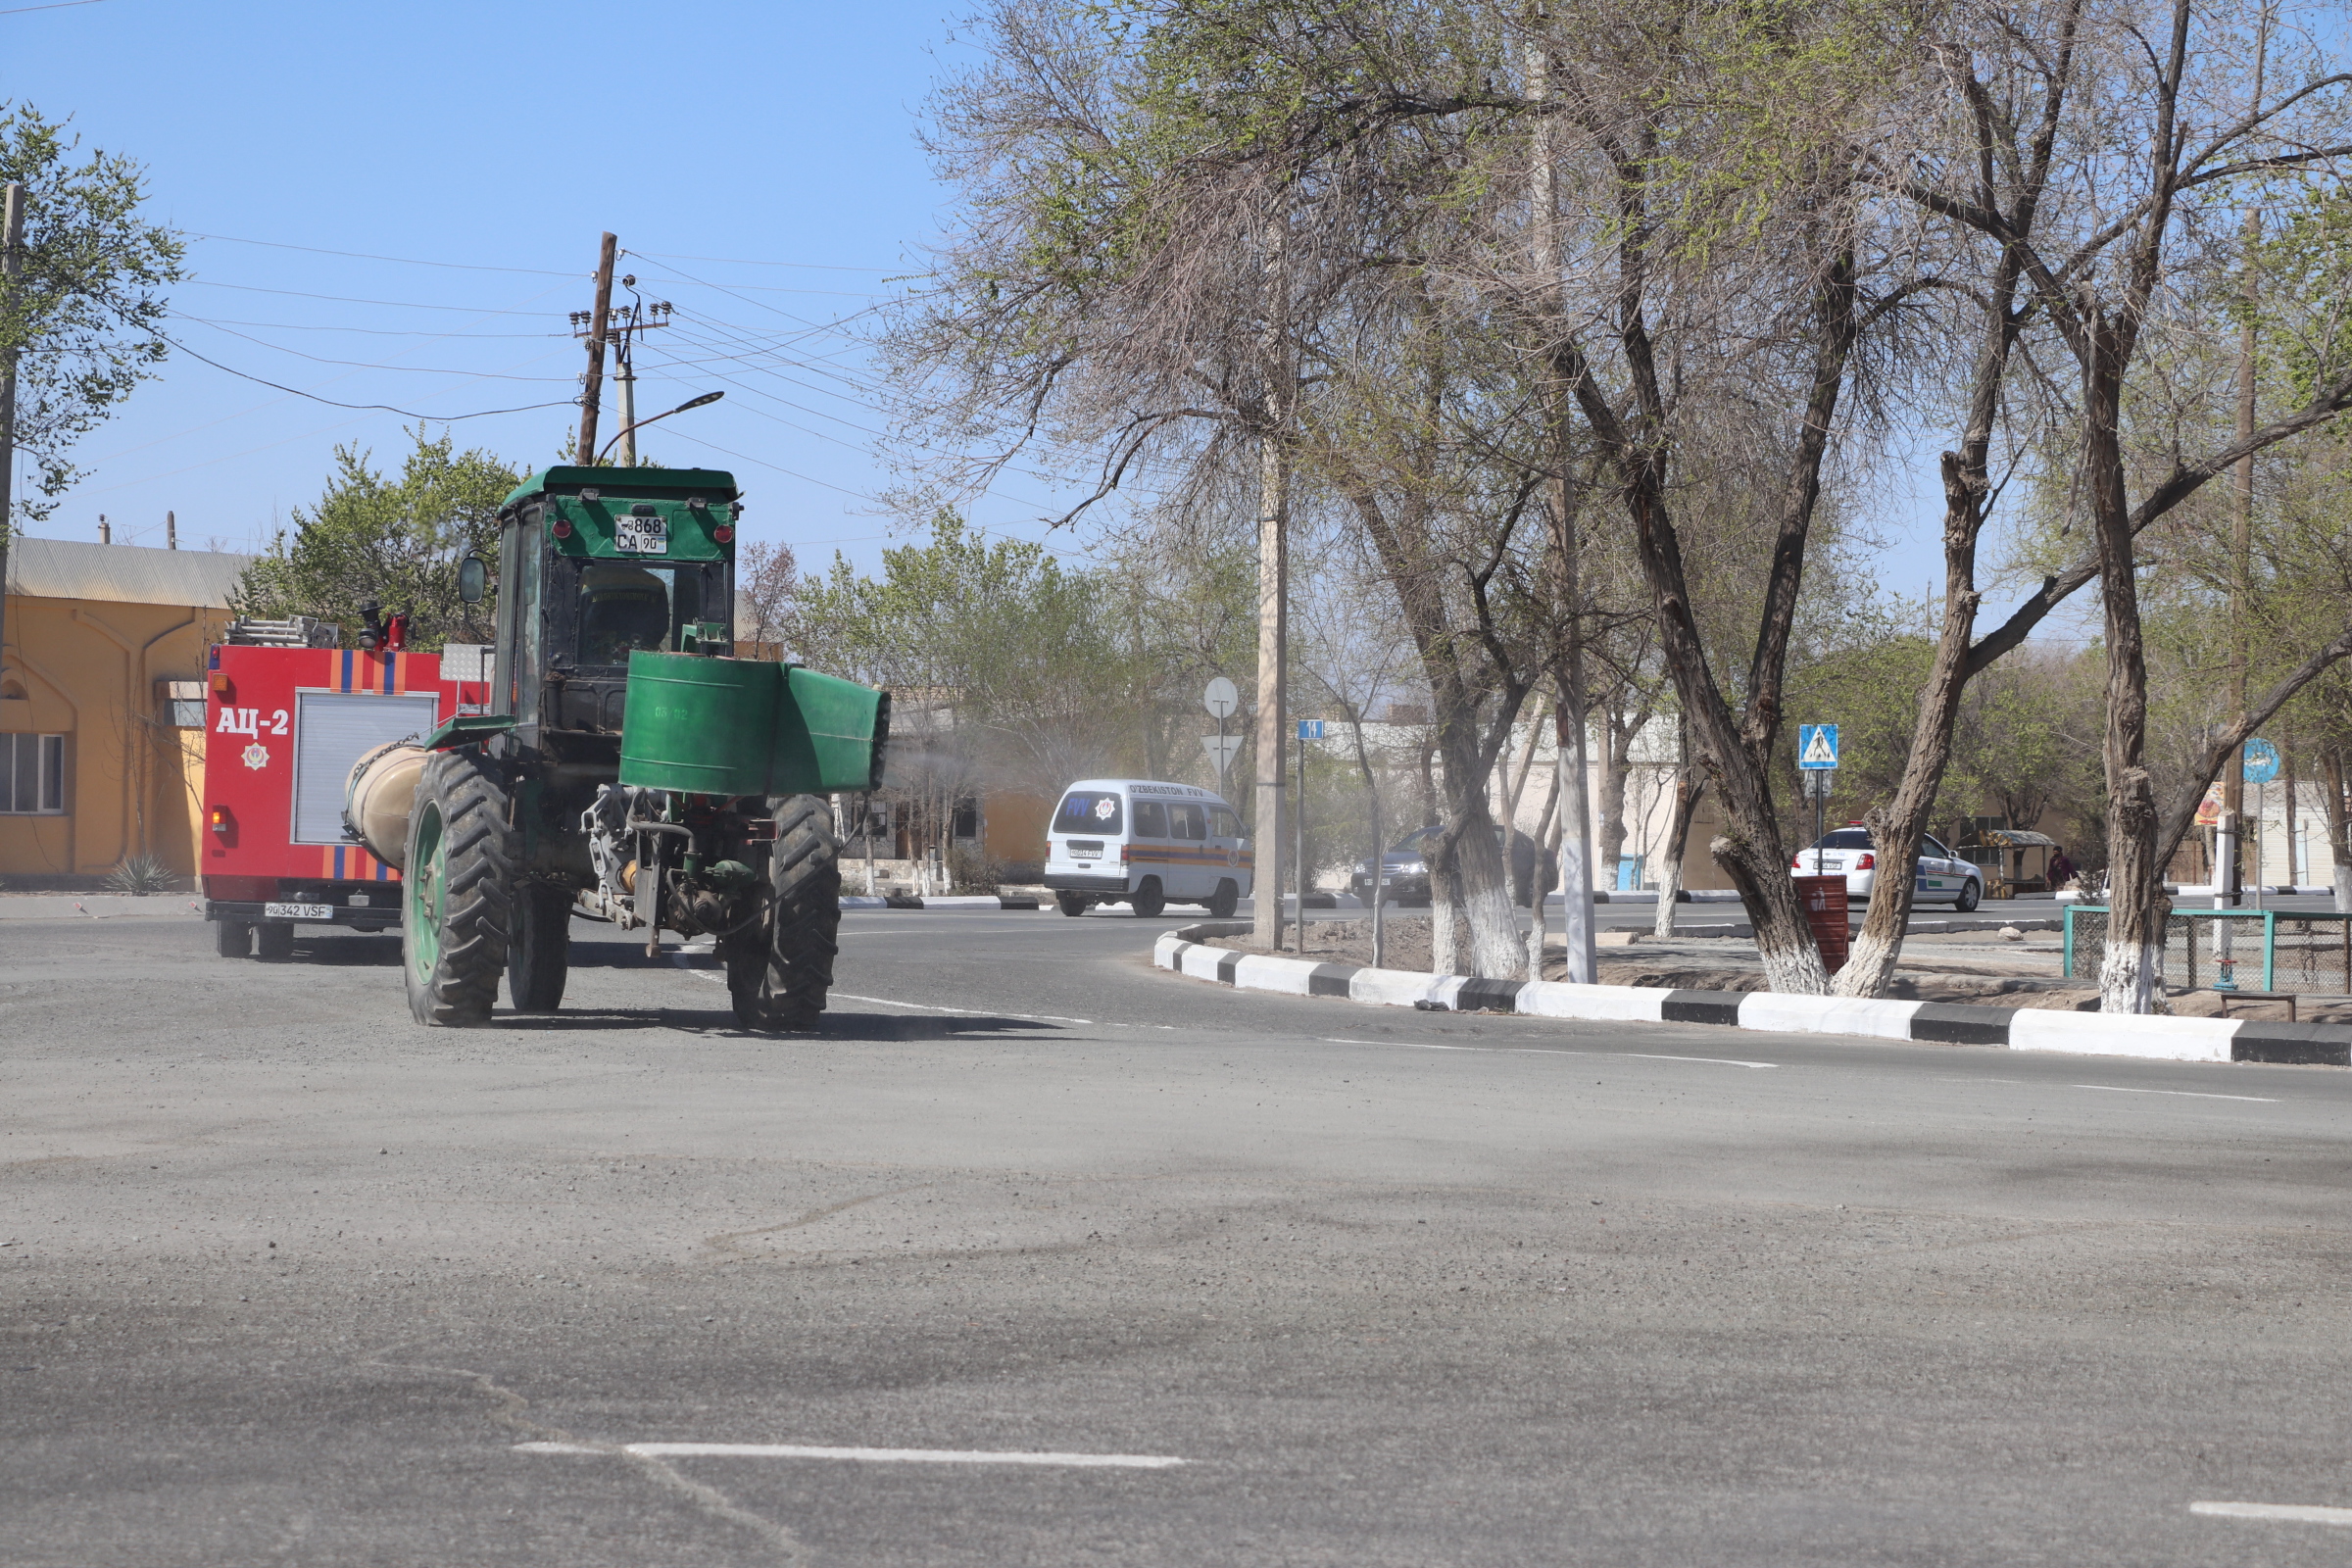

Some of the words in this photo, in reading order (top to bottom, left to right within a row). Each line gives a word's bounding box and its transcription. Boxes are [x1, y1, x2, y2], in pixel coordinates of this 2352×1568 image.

[634, 518, 662, 533] 868
[617, 534, 638, 550] CA
[643, 537, 657, 549] 90
[216, 707, 288, 739] АЦ-2
[1306, 721, 1317, 738] 14
[1129, 784, 1184, 796] O'ZBEKISTON
[1187, 788, 1203, 797] FVV
[268, 906, 278, 914] 90
[279, 905, 300, 916] 342
[303, 906, 326, 917] VSF
